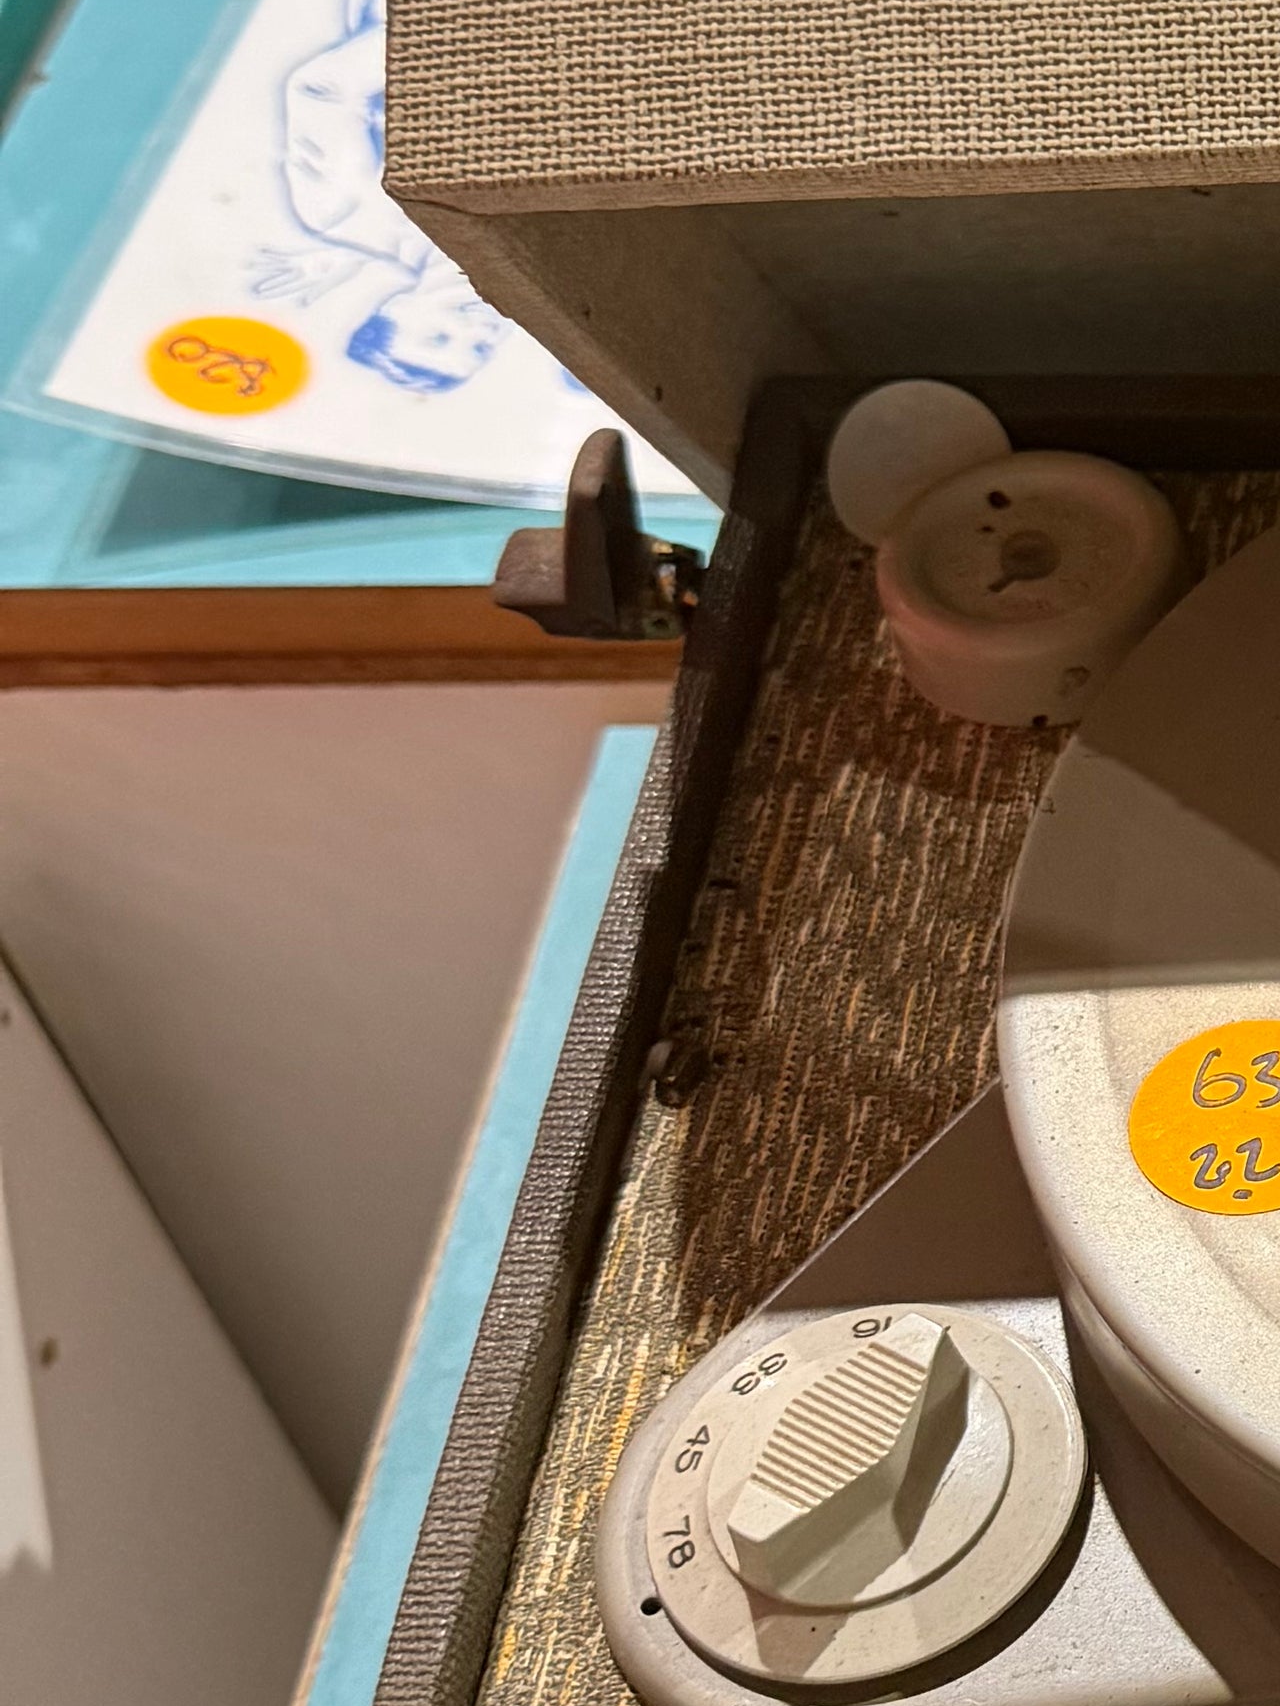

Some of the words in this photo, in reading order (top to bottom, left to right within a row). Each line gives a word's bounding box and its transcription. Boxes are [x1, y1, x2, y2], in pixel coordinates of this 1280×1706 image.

[732, 1353, 788, 1396] 33
[674, 1424, 711, 1474] 45
[663, 1513, 696, 1569] 78
